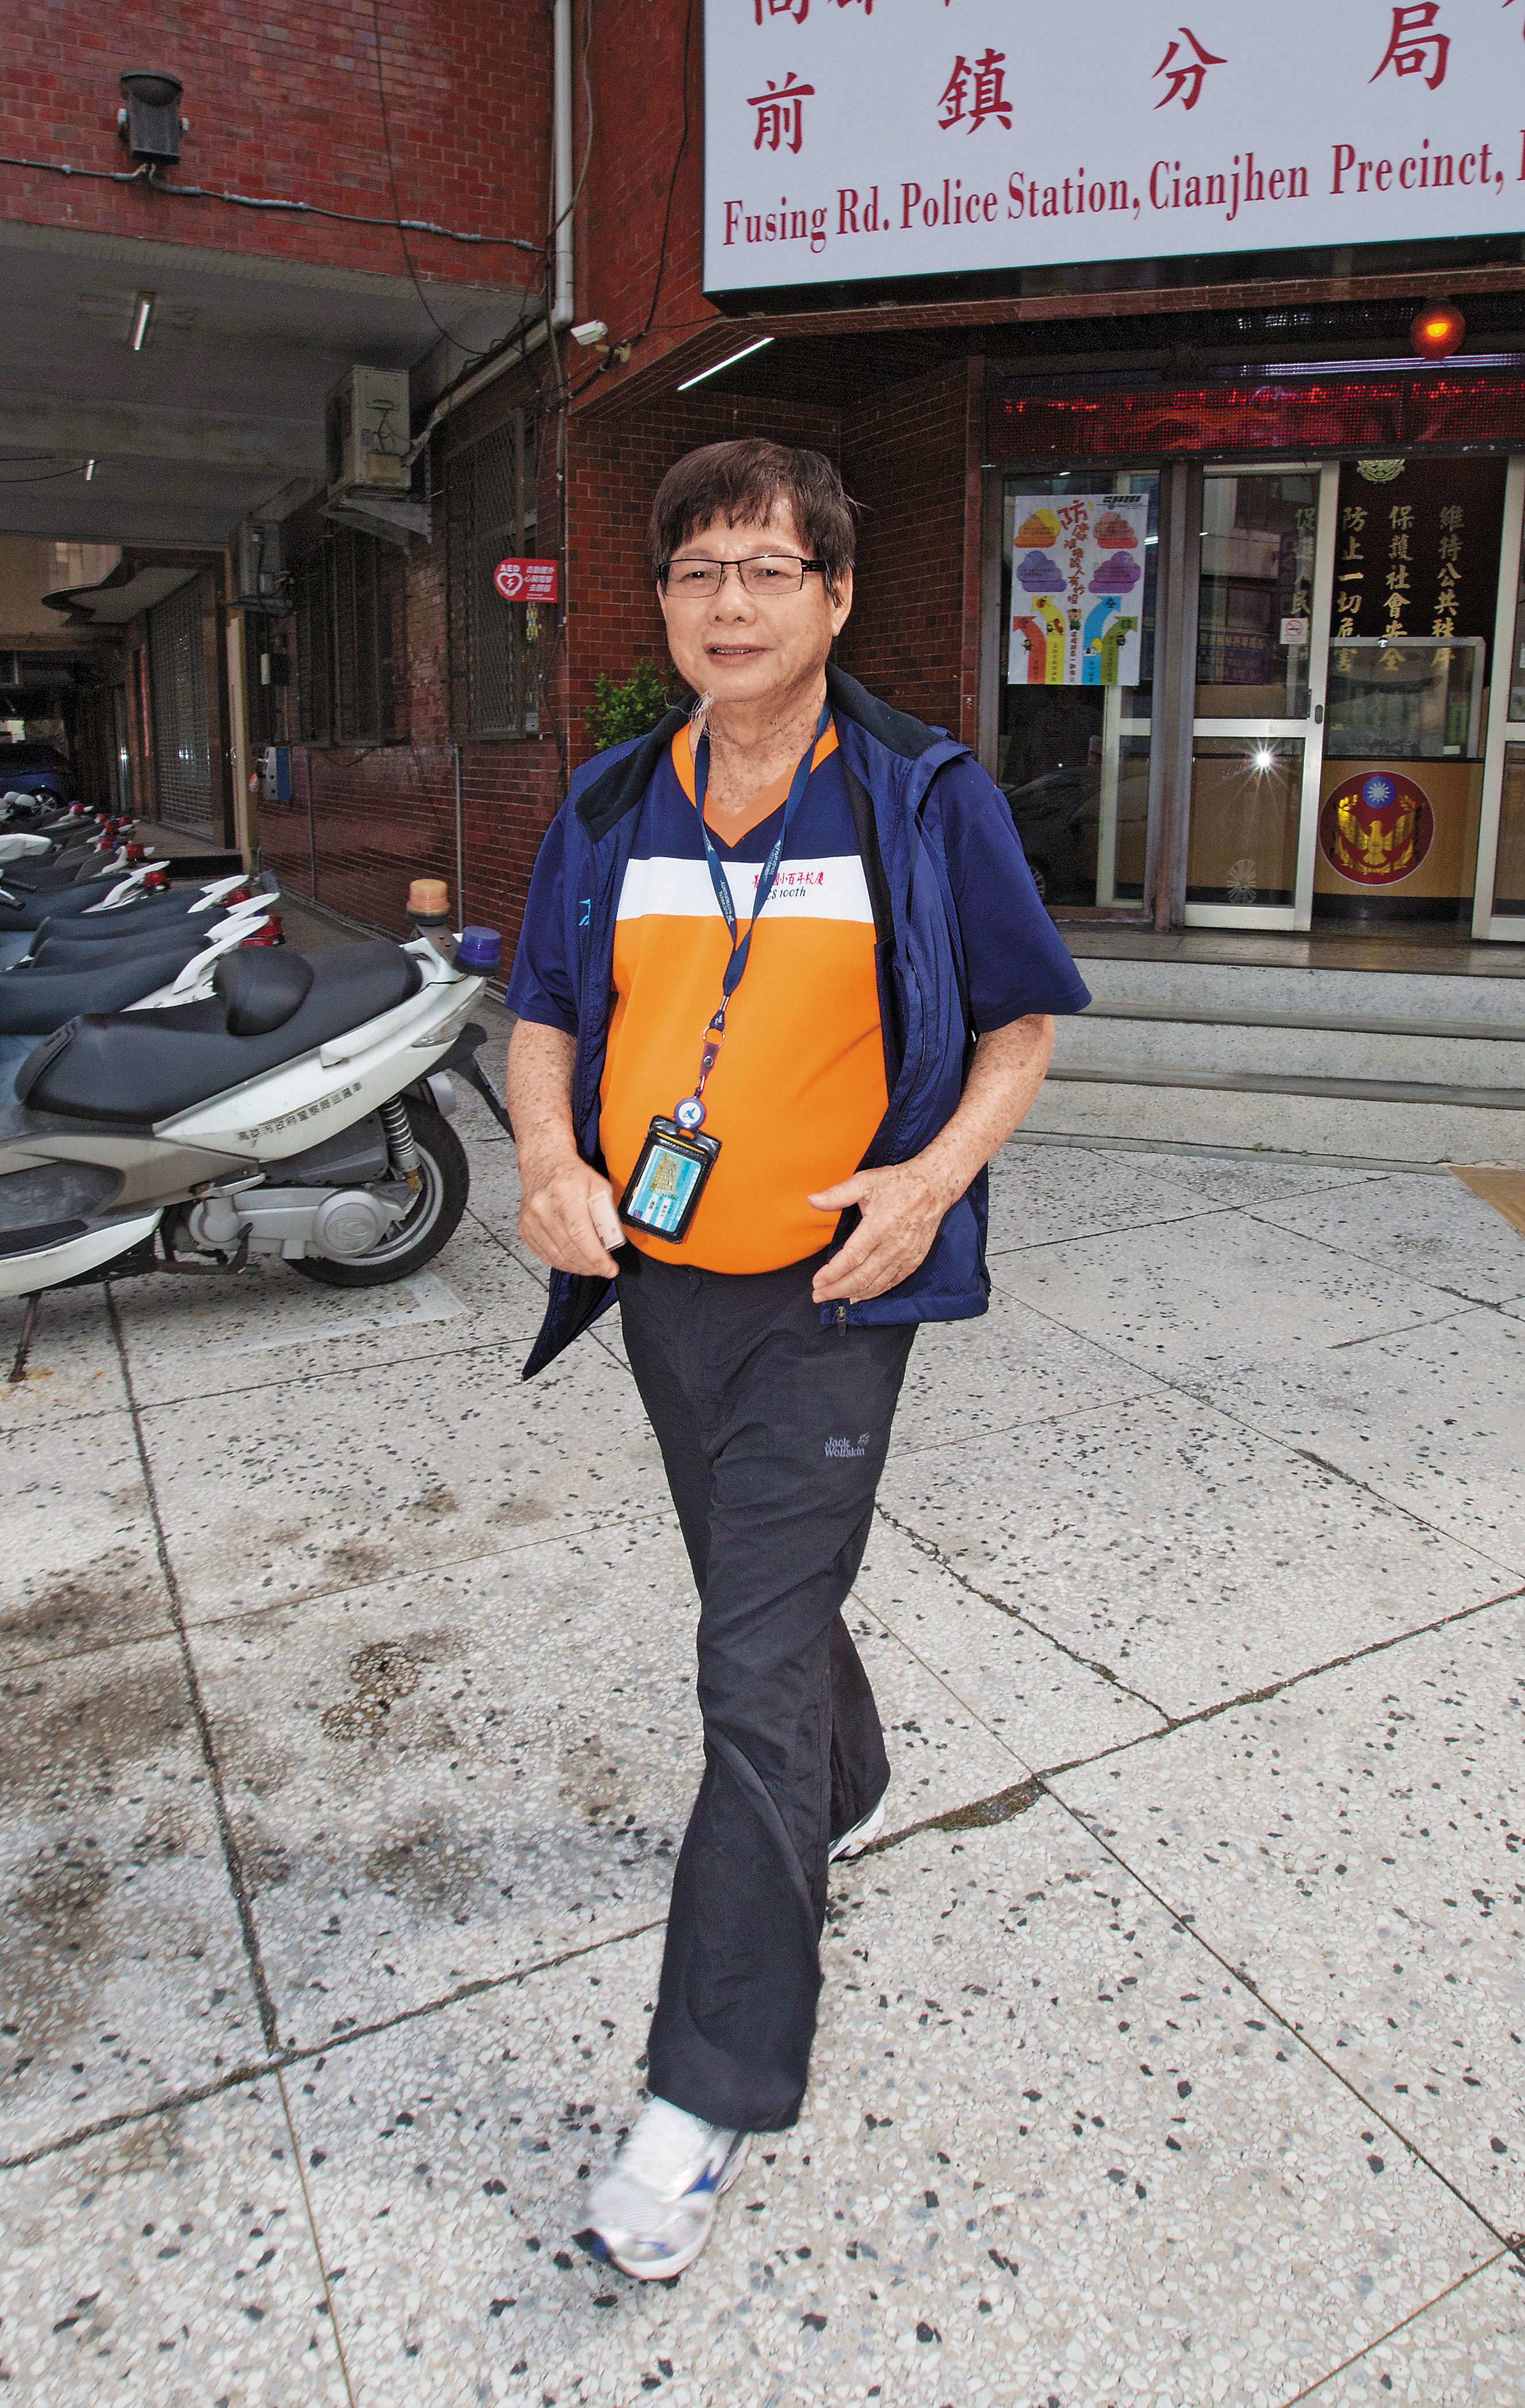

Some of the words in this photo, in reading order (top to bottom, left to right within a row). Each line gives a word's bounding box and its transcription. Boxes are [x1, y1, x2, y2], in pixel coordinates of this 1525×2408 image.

[746, 2, 1450, 154] 前鎮分局
[723, 197, 827, 254] Fusing
[836, 186, 890, 235] Rd.
[900, 179, 998, 229] Police
[1007, 167, 1140, 220] Station,
[1149, 153, 1308, 221] Cianjhen
[1329, 139, 1503, 195] Precinct,
[500, 564, 520, 572] AED
[825, 1436, 850, 1447] Jack
[825, 1446, 865, 1457] Wolfskin
